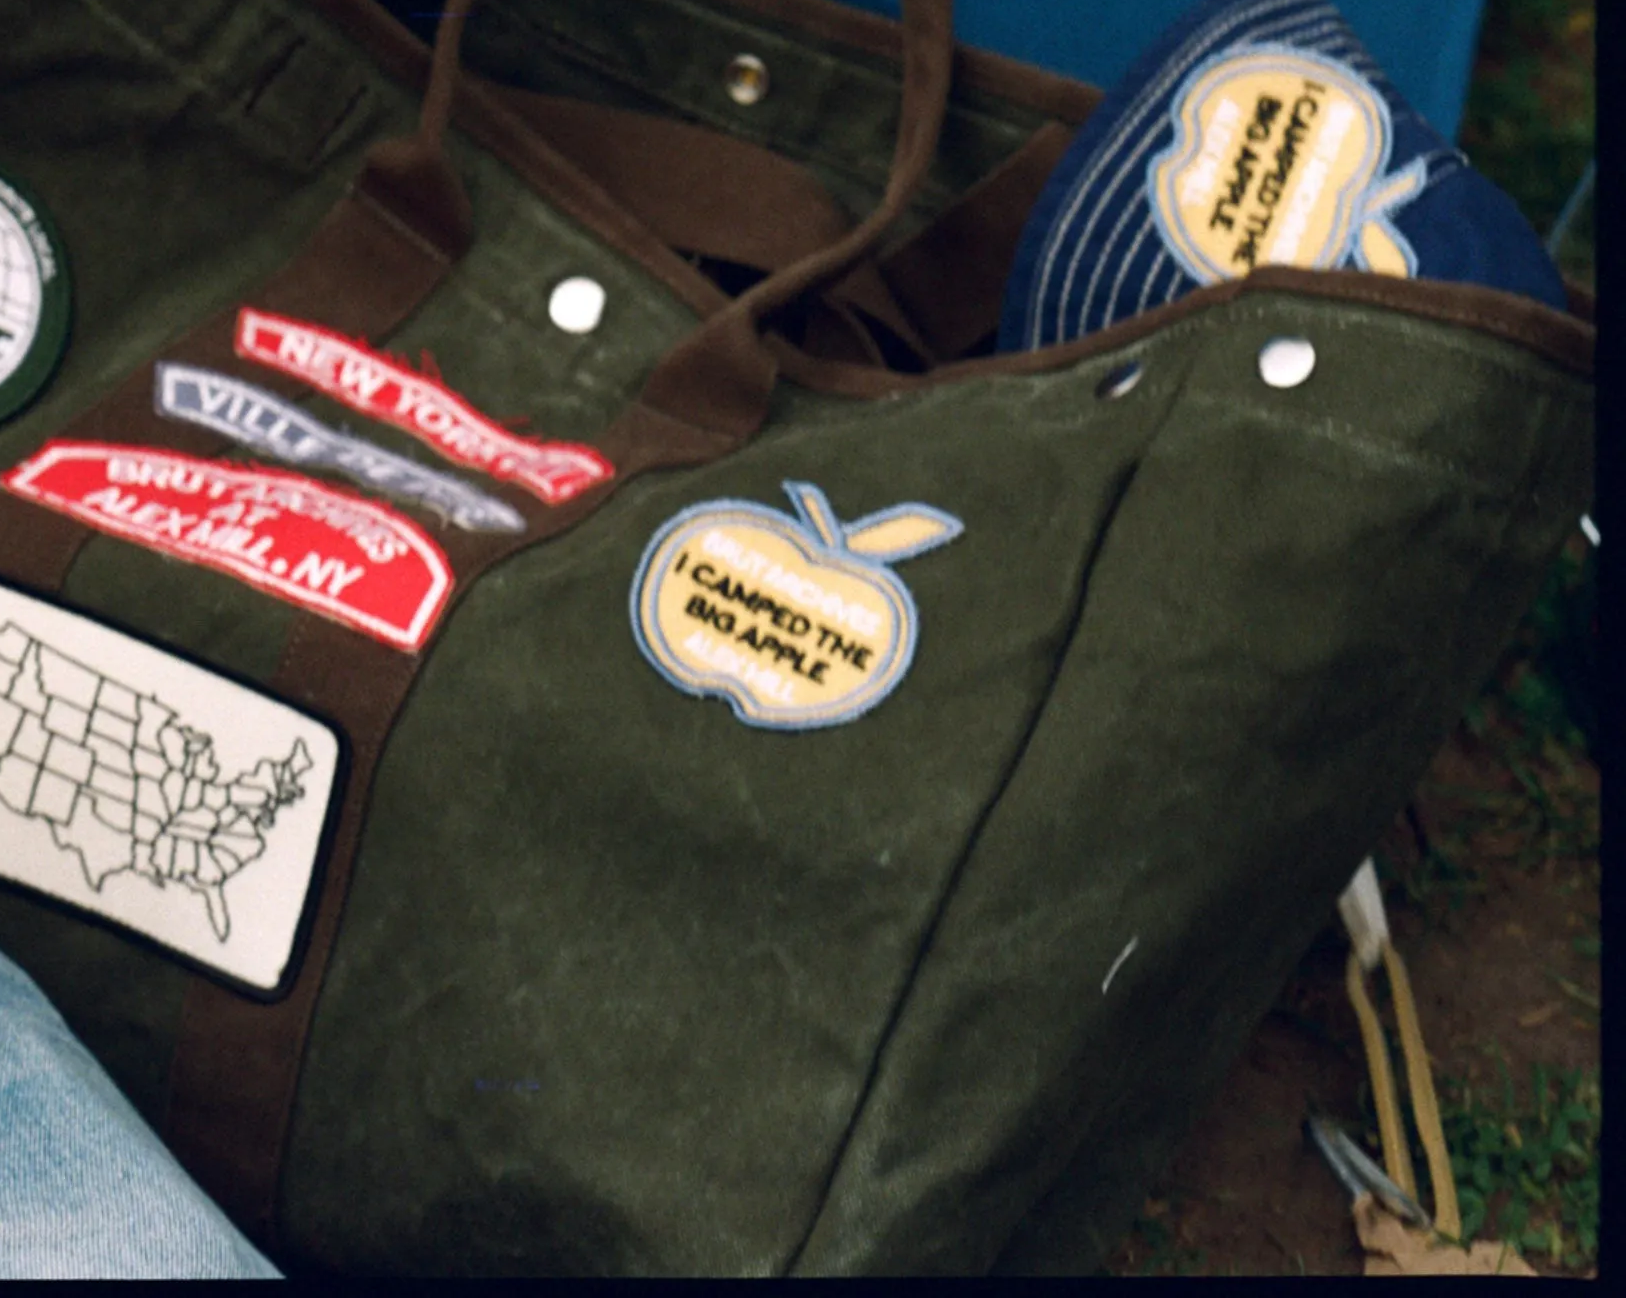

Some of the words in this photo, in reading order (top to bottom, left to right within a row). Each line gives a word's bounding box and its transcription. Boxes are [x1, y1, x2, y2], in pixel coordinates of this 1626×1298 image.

[278, 327, 388, 408] NEW
[80, 485, 198, 539] ALEX
[290, 551, 366, 598] NY
[673, 551, 690, 575] I
[690, 562, 812, 638] CAMPED
[815, 624, 875, 673] THE
[684, 593, 737, 635] BIG
[735, 625, 831, 686] APPLE
